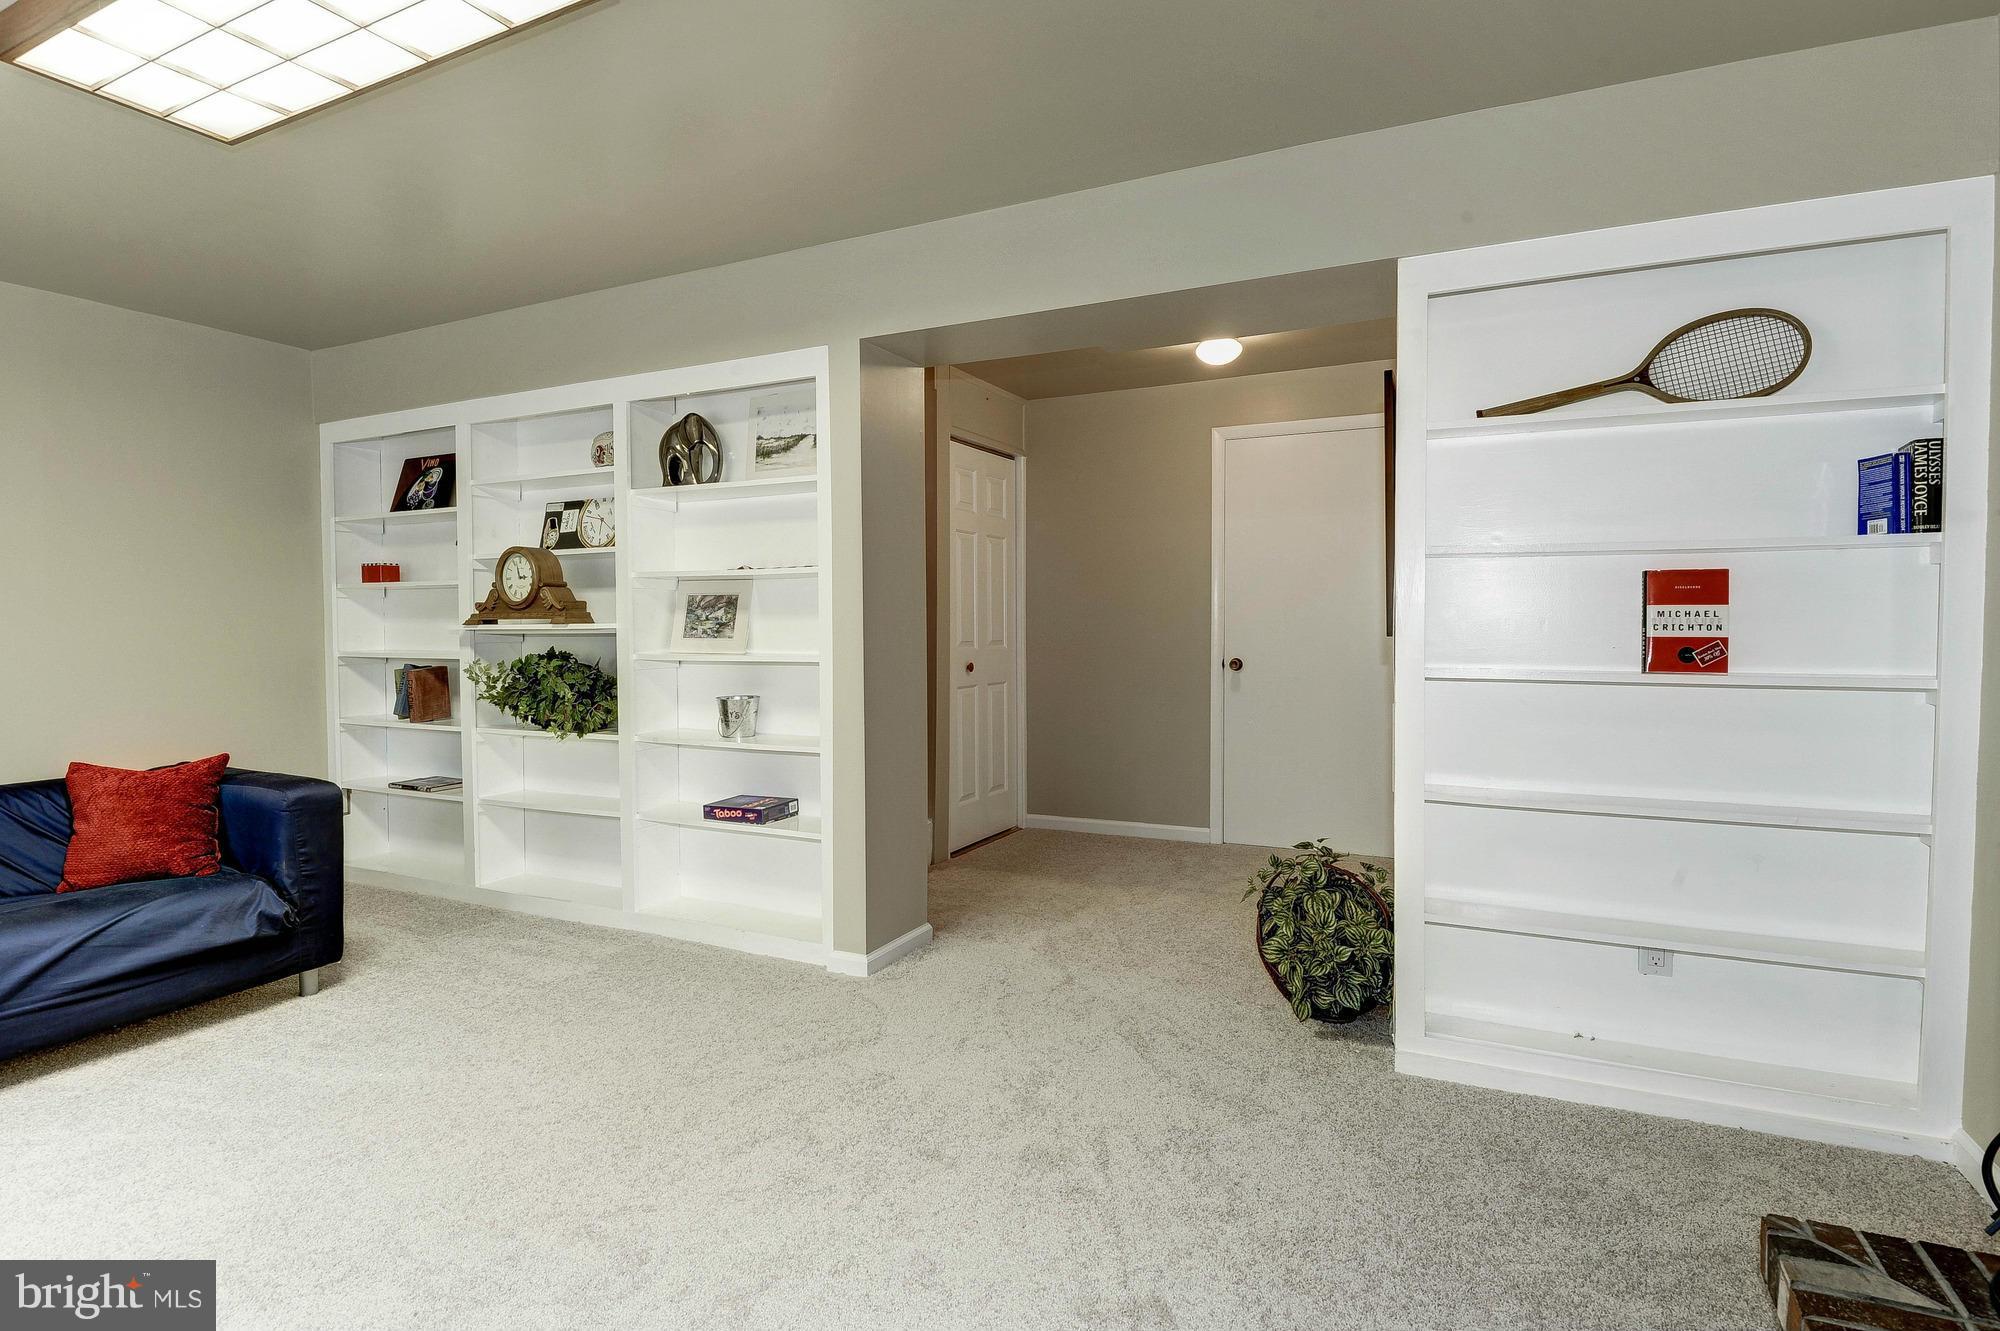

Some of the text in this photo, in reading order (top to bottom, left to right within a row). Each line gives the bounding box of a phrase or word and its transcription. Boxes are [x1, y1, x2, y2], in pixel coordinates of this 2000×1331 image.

[1914, 441, 1928, 516] JAMES JOYCE
[1928, 440, 1942, 485] ULYSSES
[713, 808, 742, 819] Taboo
